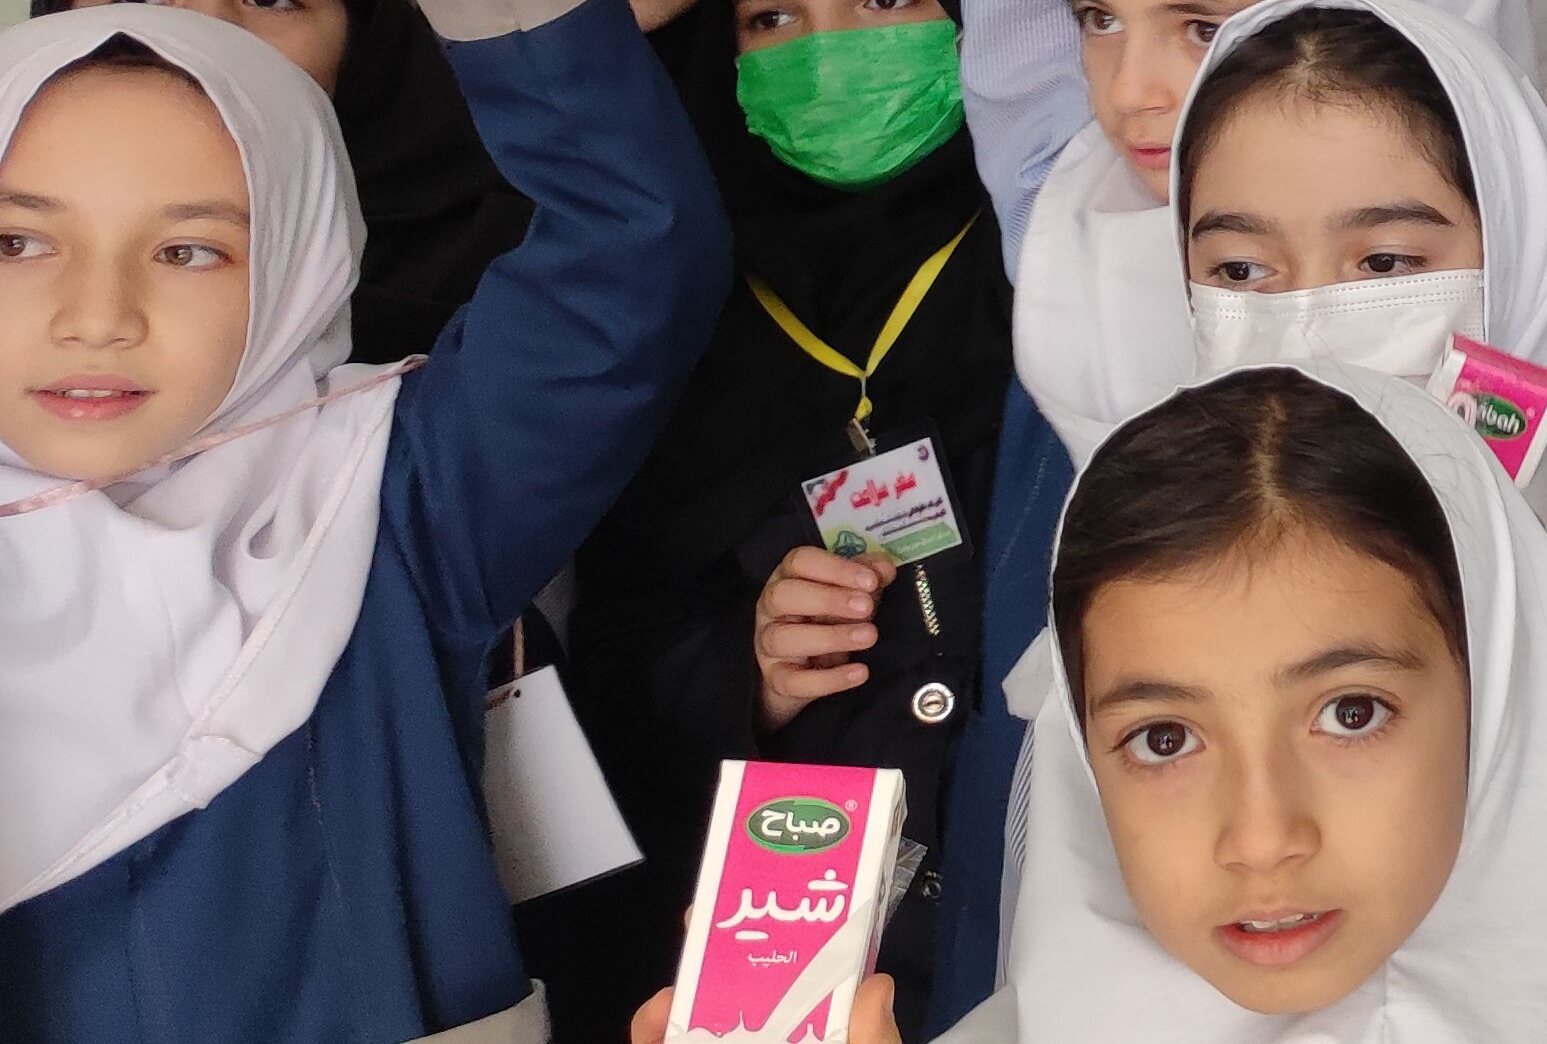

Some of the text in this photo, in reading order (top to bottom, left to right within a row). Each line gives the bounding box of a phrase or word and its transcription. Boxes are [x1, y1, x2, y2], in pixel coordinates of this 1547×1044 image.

[1480, 401, 1520, 435] abah
[760, 809, 841, 840] صباح
[715, 868, 850, 941] شیر
